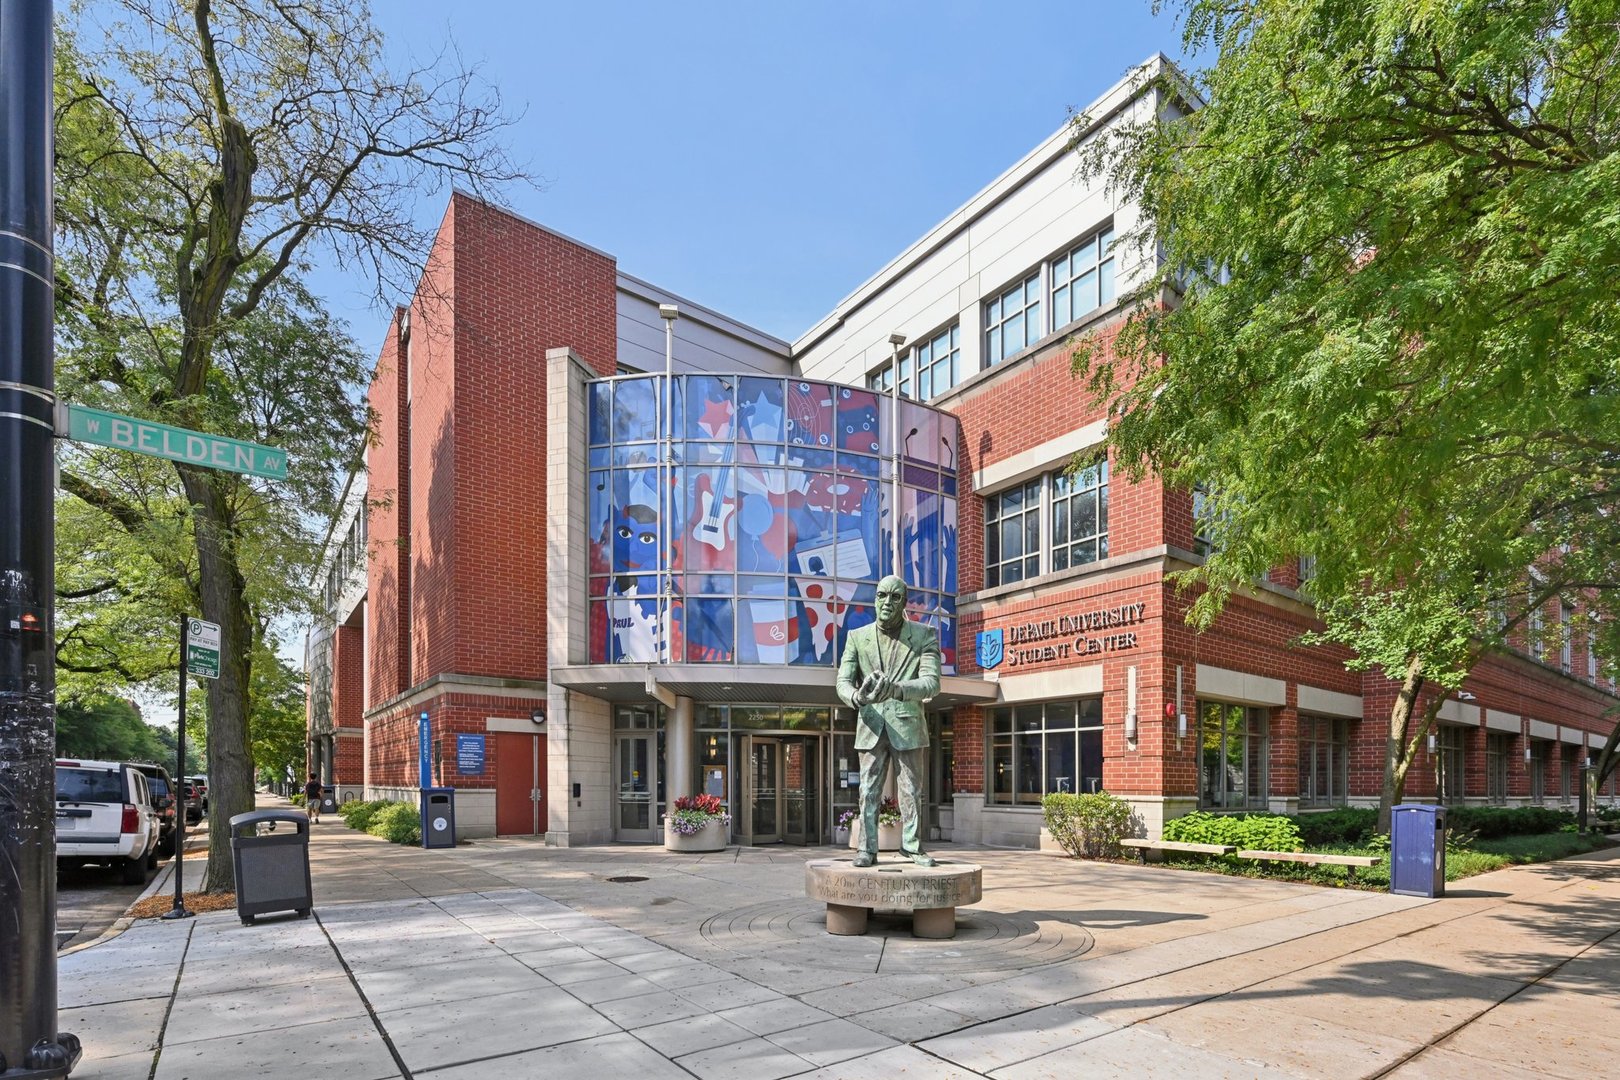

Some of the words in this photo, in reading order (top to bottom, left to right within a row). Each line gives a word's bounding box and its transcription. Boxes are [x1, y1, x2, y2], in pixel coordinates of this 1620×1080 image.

[86, 418, 100, 435] W
[111, 419, 255, 471] BELDEN
[263, 455, 281, 471] AV
[1007, 643, 1070, 666] STUDENT
[1073, 631, 1138, 656] CENTER
[858, 876, 919, 891] CENTURY
[923, 877, 958, 891] PRIEST
[841, 891, 856, 900] are
[858, 892, 878, 904] you
[881, 890, 913, 906] doing
[916, 890, 930, 903] for
